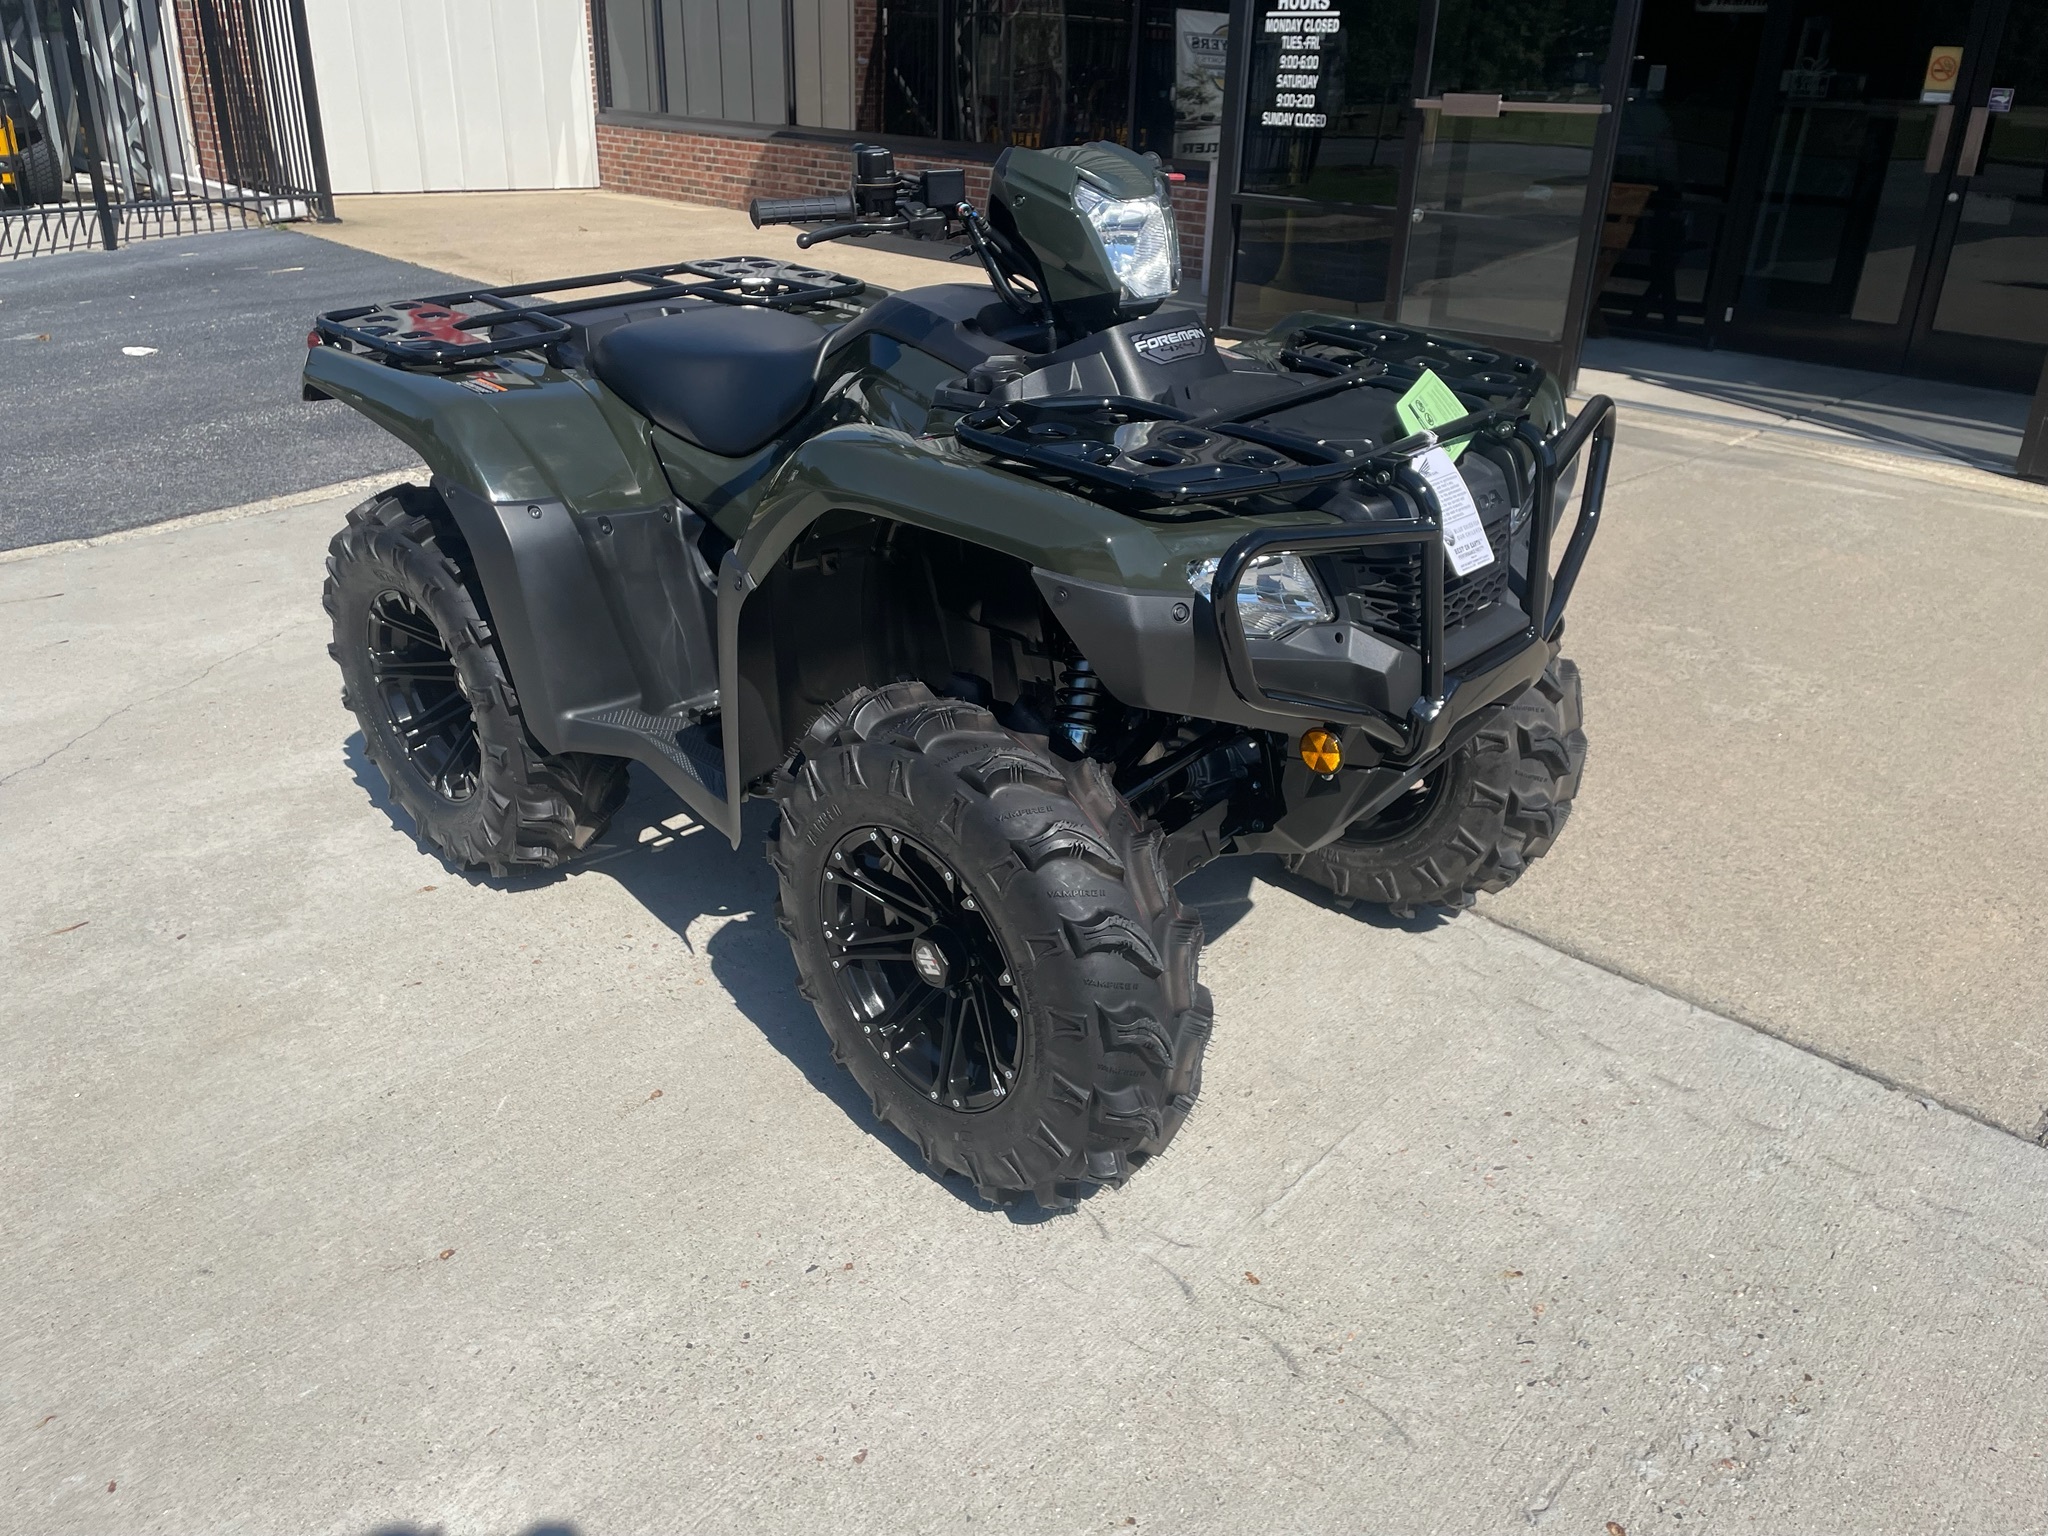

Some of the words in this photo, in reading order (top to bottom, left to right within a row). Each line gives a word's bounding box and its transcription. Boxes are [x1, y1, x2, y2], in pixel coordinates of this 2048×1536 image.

[1277, 0, 1331, 10] HOURS
[1264, 18, 1303, 33] MONDAY
[1303, 18, 1340, 33] CLOSED
[1275, 74, 1319, 89] SATURDAY
[1261, 111, 1294, 127] SUNDAY
[1294, 113, 1327, 128] CLOSED
[1134, 328, 1206, 353] FOREMAN
[995, 806, 1046, 821] VAMPIRE
[1047, 889, 1098, 898] VAMPIRE
